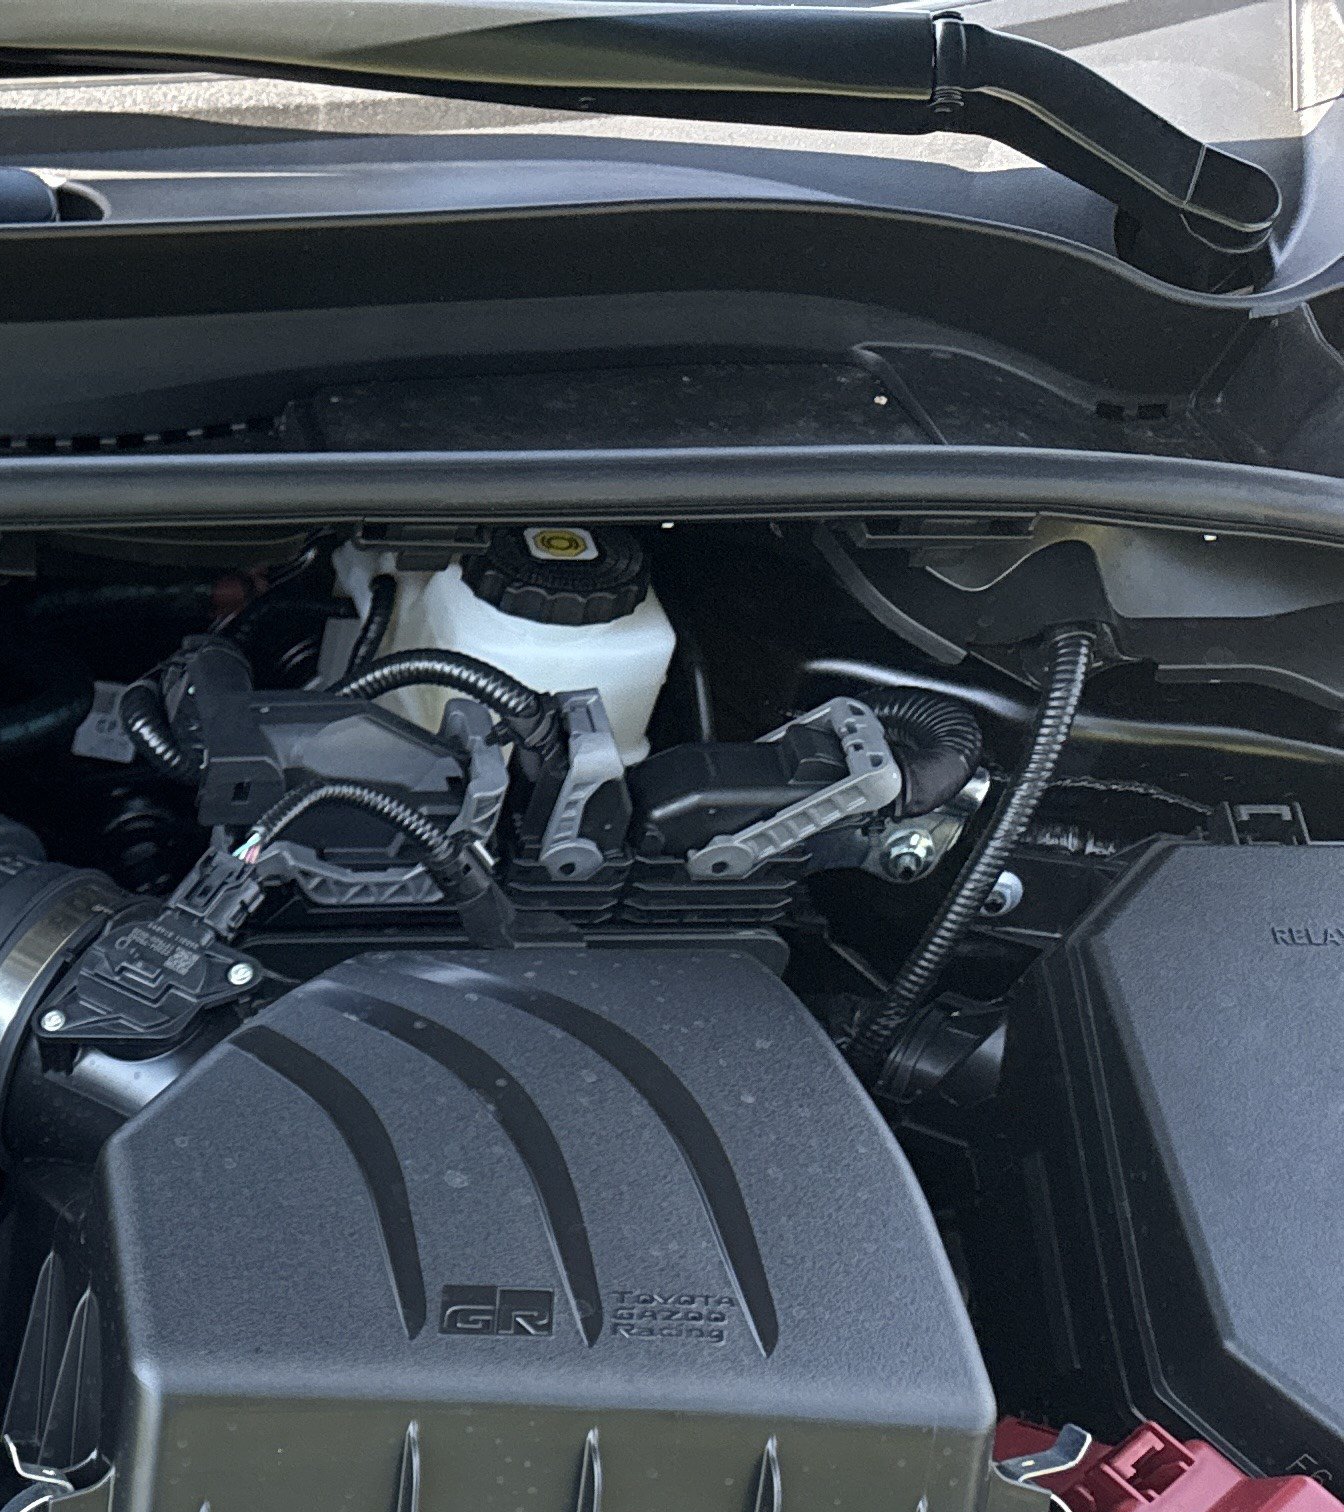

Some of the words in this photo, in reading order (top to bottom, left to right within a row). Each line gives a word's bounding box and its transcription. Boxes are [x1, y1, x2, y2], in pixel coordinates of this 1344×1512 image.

[1271, 926, 1344, 946] RELA
[612, 1290, 736, 1308] TOYOTA
[442, 1304, 550, 1336] GR
[612, 1308, 729, 1325] GAZOO
[611, 1323, 726, 1346] Racing
